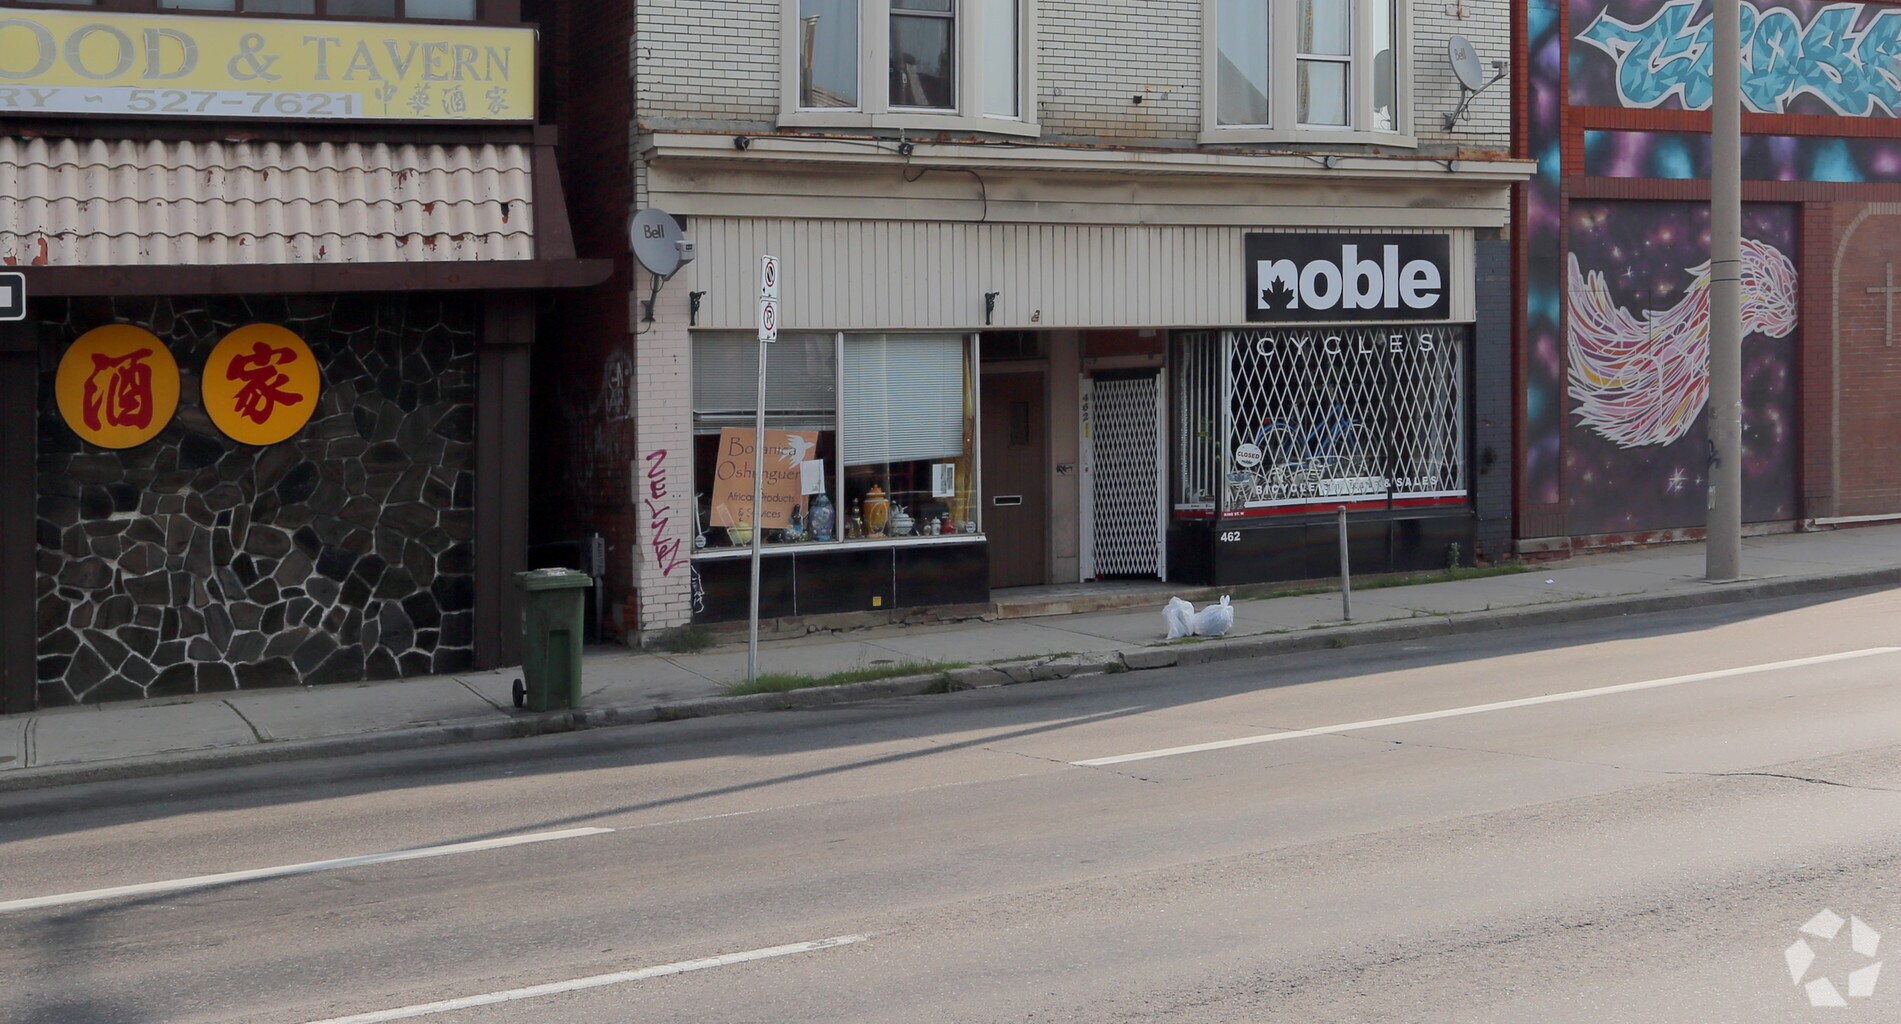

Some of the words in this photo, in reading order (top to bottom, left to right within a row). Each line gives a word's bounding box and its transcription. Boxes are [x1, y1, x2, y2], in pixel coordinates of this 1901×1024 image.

[226, 32, 282, 82] &
[303, 35, 512, 81] TAVERN
[127, 89, 353, 115] 527-7621
[643, 224, 665, 239] Bell
[1257, 244, 1442, 310] noble
[1256, 333, 1434, 356] CYCLES
[83, 347, 154, 433] 酒
[226, 341, 304, 425] 家
[728, 436, 797, 457] Boanica
[1237, 451, 1260, 460] CLOSED
[1255, 482, 1316, 495] BICYCLE
[1396, 476, 1438, 488] SALES
[727, 491, 756, 503] Africa
[761, 492, 796, 503] roducts
[746, 508, 781, 519] Svices
[1220, 531, 1241, 543] 462
